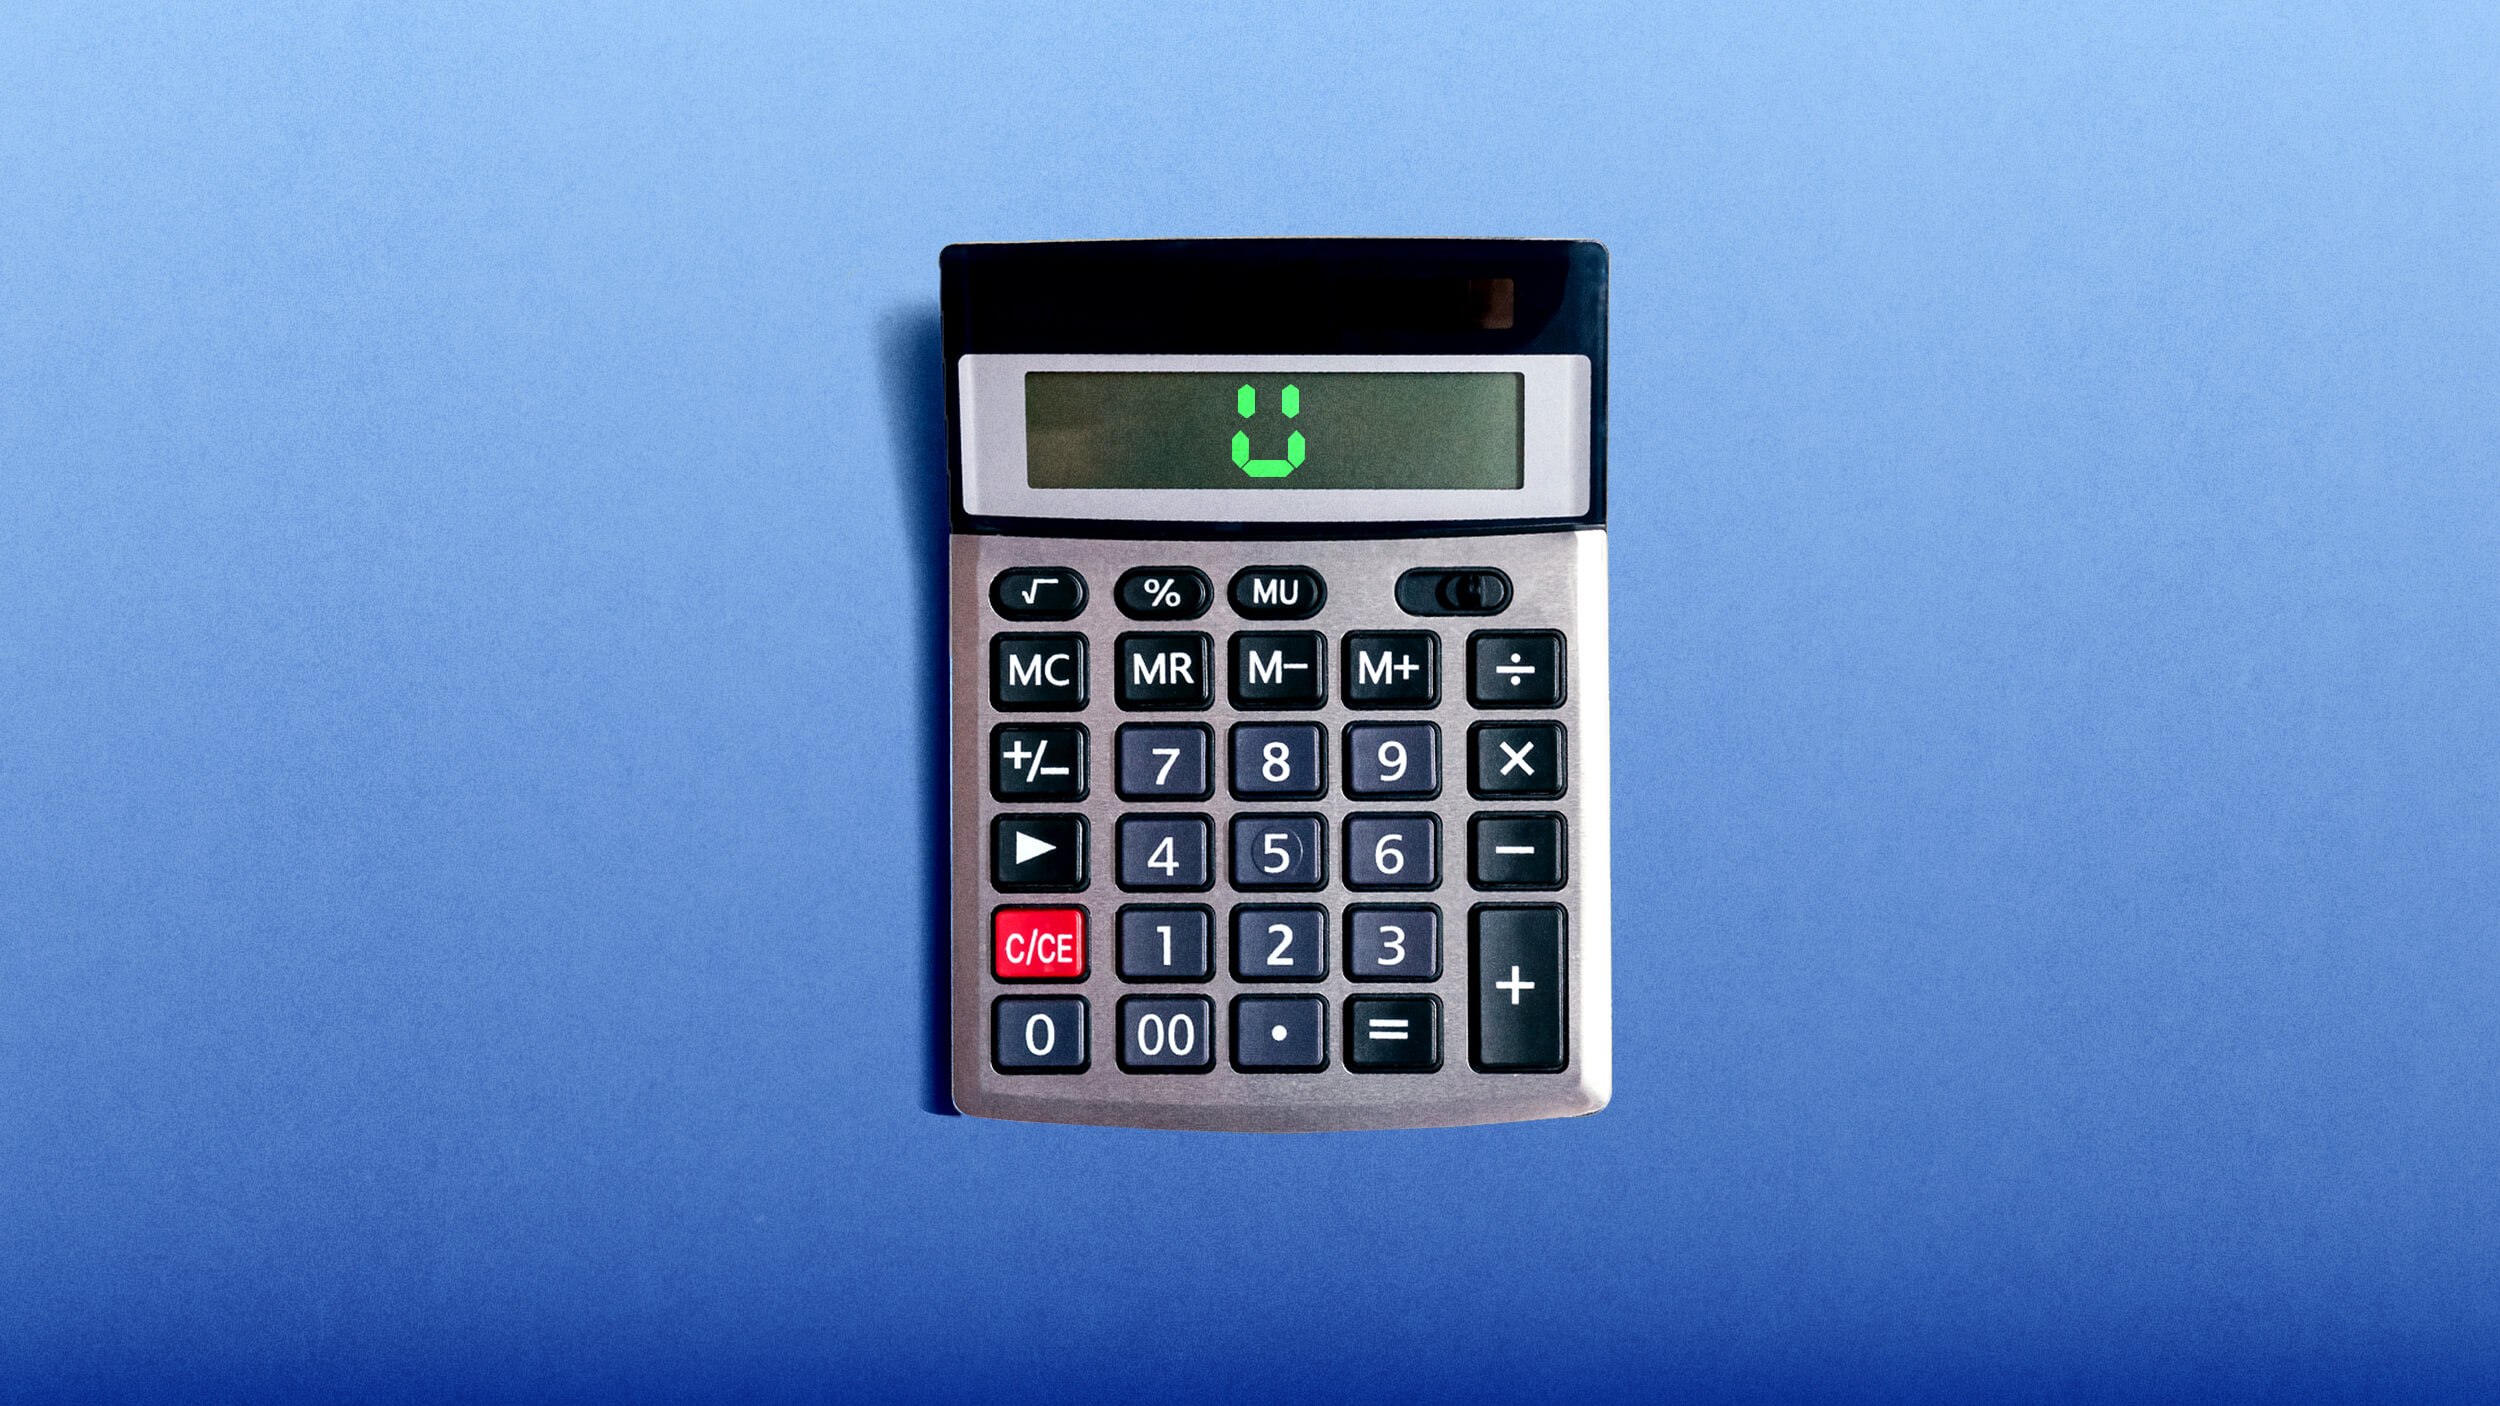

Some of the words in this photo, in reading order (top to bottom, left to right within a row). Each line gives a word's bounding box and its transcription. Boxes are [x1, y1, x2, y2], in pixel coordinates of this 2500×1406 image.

[1143, 579, 1181, 607] %
[1253, 578, 1299, 605] MU
[1009, 653, 1070, 687] MC
[1133, 652, 1194, 685] MR
[1358, 650, 1420, 685] M+
[1152, 748, 1181, 785] 7
[1262, 741, 1291, 782] 8
[1377, 740, 1408, 782] 9
[1147, 836, 1180, 877] 4
[1264, 834, 1290, 874] 5
[1374, 833, 1404, 875] 6
[1005, 928, 1073, 966] C/CE
[1156, 925, 1172, 966] 1
[1266, 923, 1294, 966] 2
[1377, 925, 1406, 966] 3
[1495, 965, 1535, 1005] +
[1025, 1013, 1055, 1056] 0
[1137, 1013, 1195, 1056] 00
[1369, 1019, 1409, 1040] =
